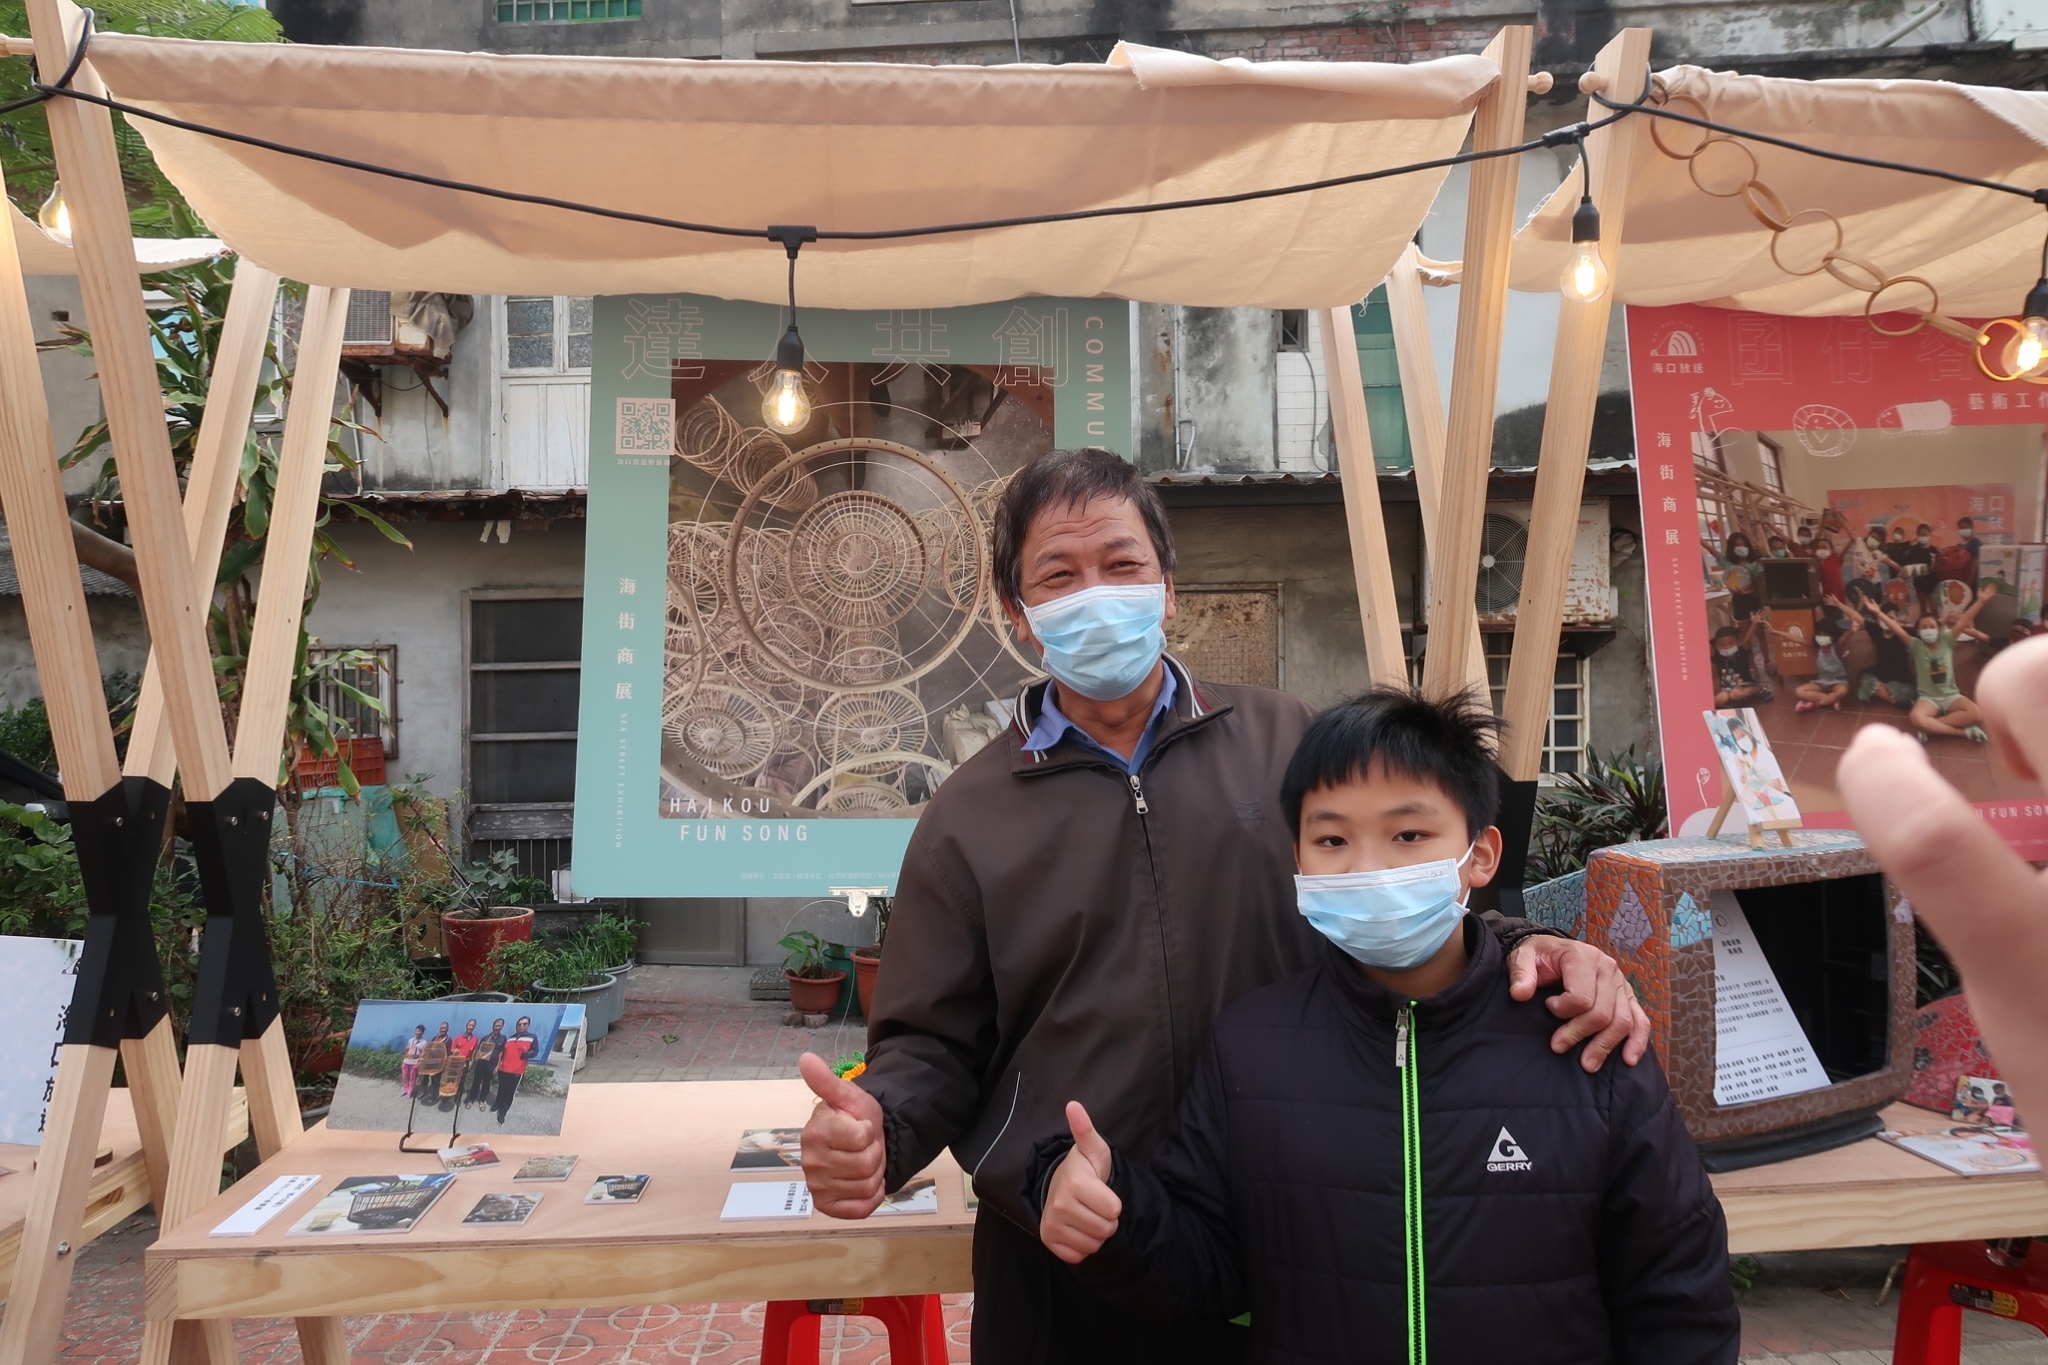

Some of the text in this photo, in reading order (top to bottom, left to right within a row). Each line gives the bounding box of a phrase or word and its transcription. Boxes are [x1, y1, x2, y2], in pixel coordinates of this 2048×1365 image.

[1085, 316, 1106, 451] COMMU
[1652, 362, 1704, 374] 海口放送
[1657, 432, 1680, 545] 海街商展
[1674, 581, 1683, 615] STREET
[615, 577, 637, 701] 海街商展
[1677, 621, 1688, 681] EXHIBITION
[615, 713, 628, 848] SEA STREET EXHIBITION
[670, 797, 770, 813] HAIKOU
[1989, 806, 2018, 819] FUN
[680, 824, 808, 841] FUN SONG
[1486, 1161, 1533, 1173] GERRY
